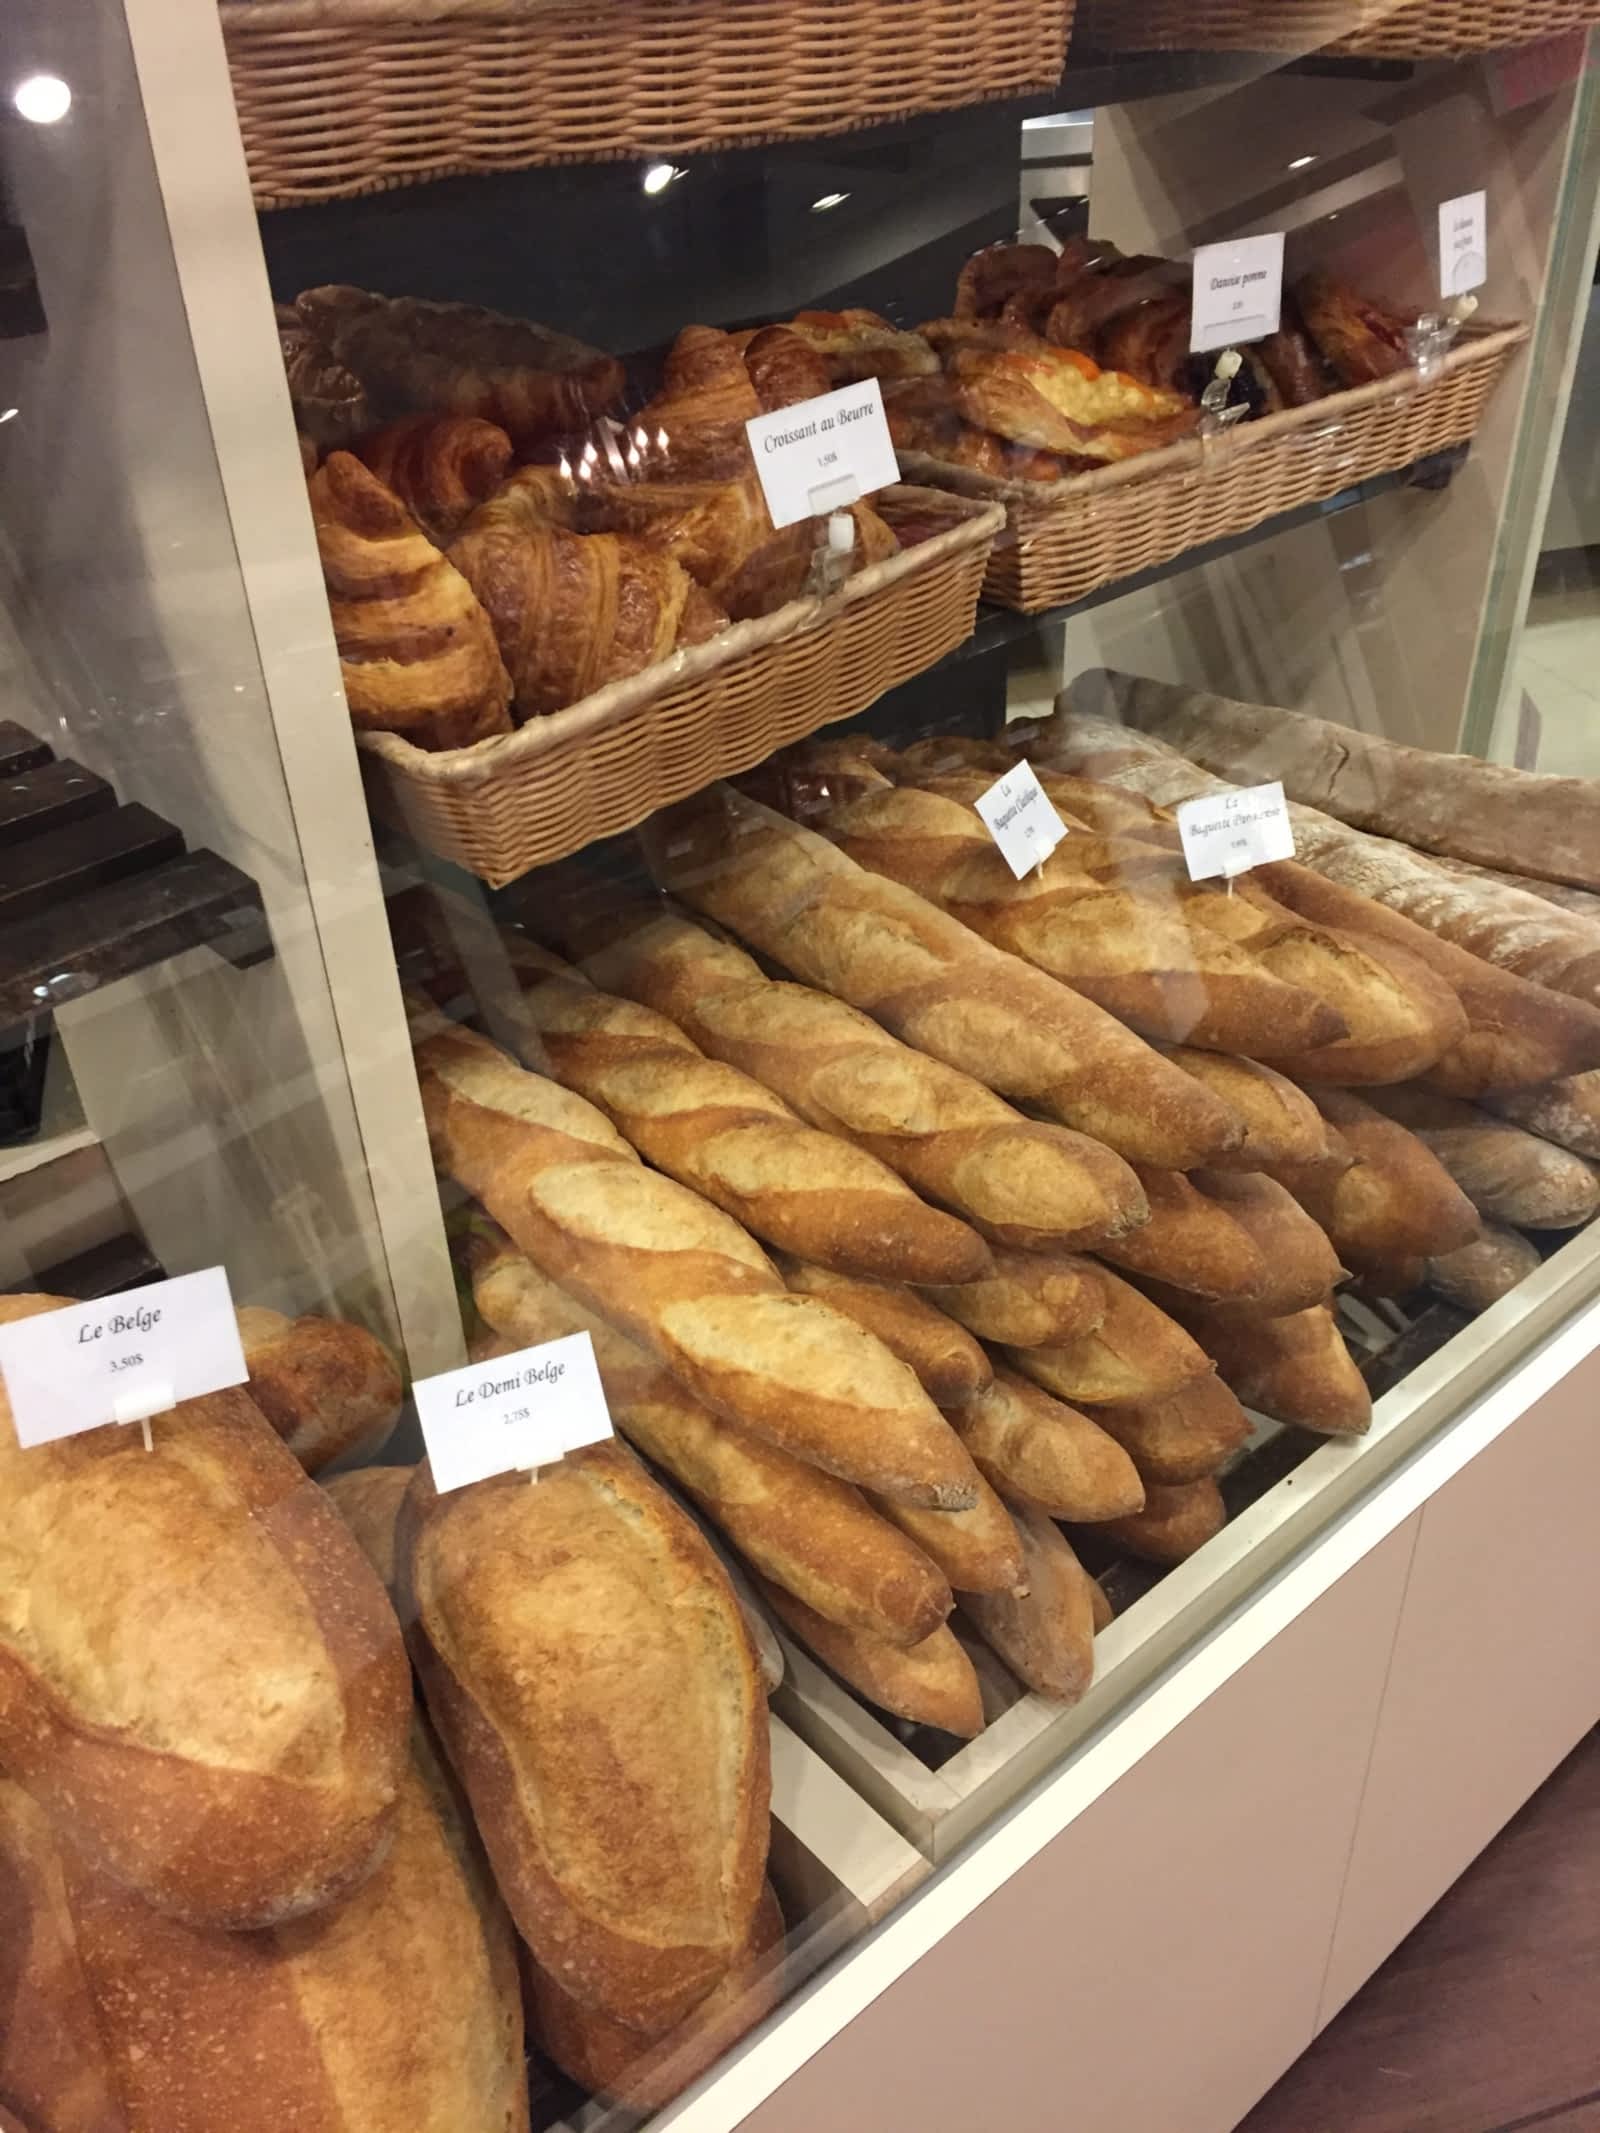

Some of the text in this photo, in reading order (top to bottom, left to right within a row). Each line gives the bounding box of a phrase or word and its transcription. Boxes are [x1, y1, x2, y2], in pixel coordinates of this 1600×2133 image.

[764, 402, 874, 453] Croissant au Beurre
[78, 1306, 162, 1344] Le Belge
[455, 1360, 565, 1407] Le Demi Belge
